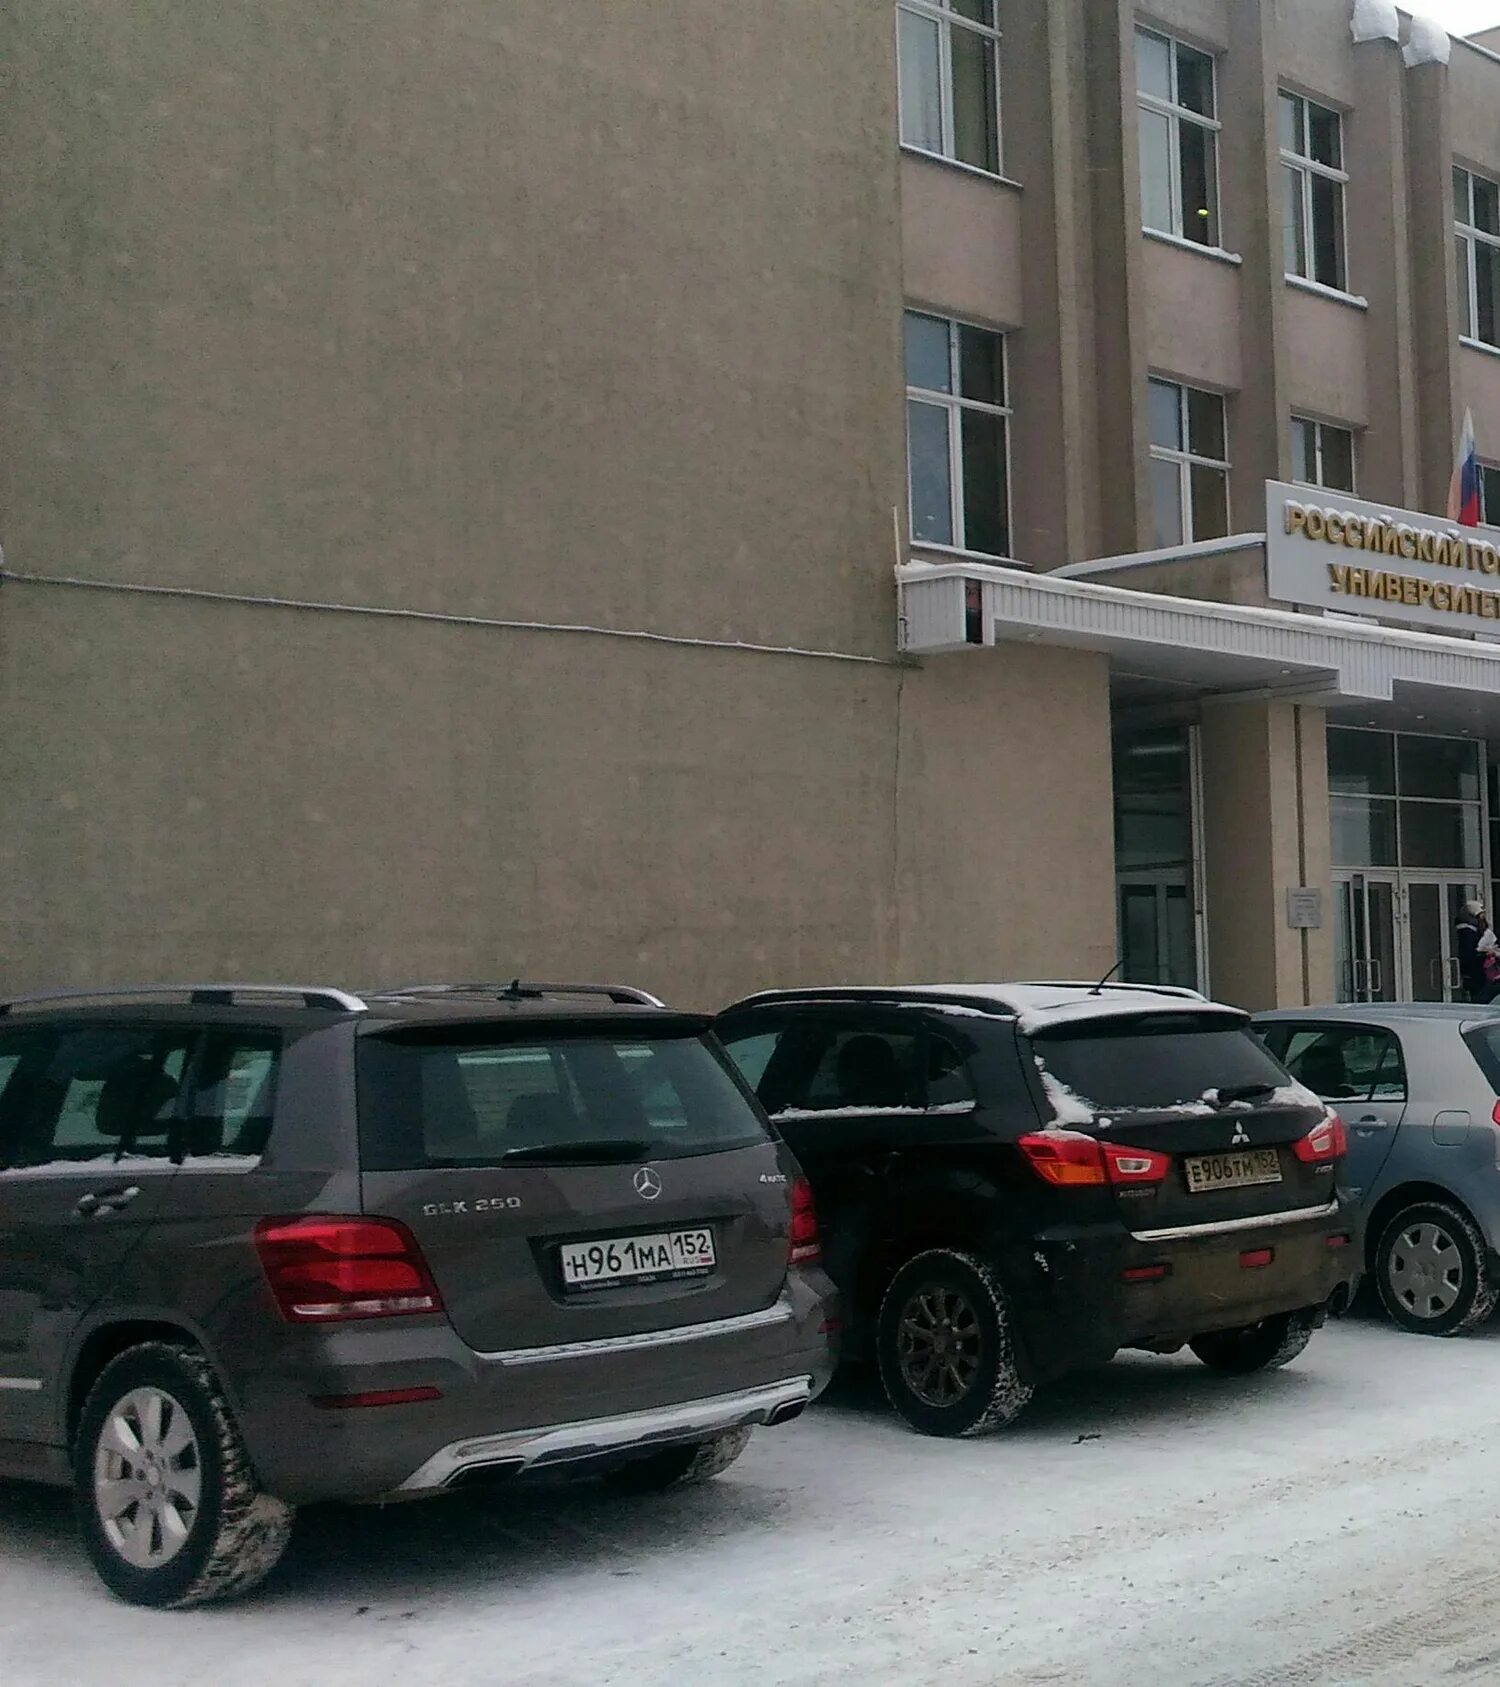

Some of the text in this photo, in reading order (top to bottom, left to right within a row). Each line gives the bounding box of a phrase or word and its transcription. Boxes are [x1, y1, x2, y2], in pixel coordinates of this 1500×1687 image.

[1284, 501, 1466, 569] РОССИЙСКИЙ
[423, 1197, 520, 1216] GLK 250
[673, 1233, 707, 1256] 152
